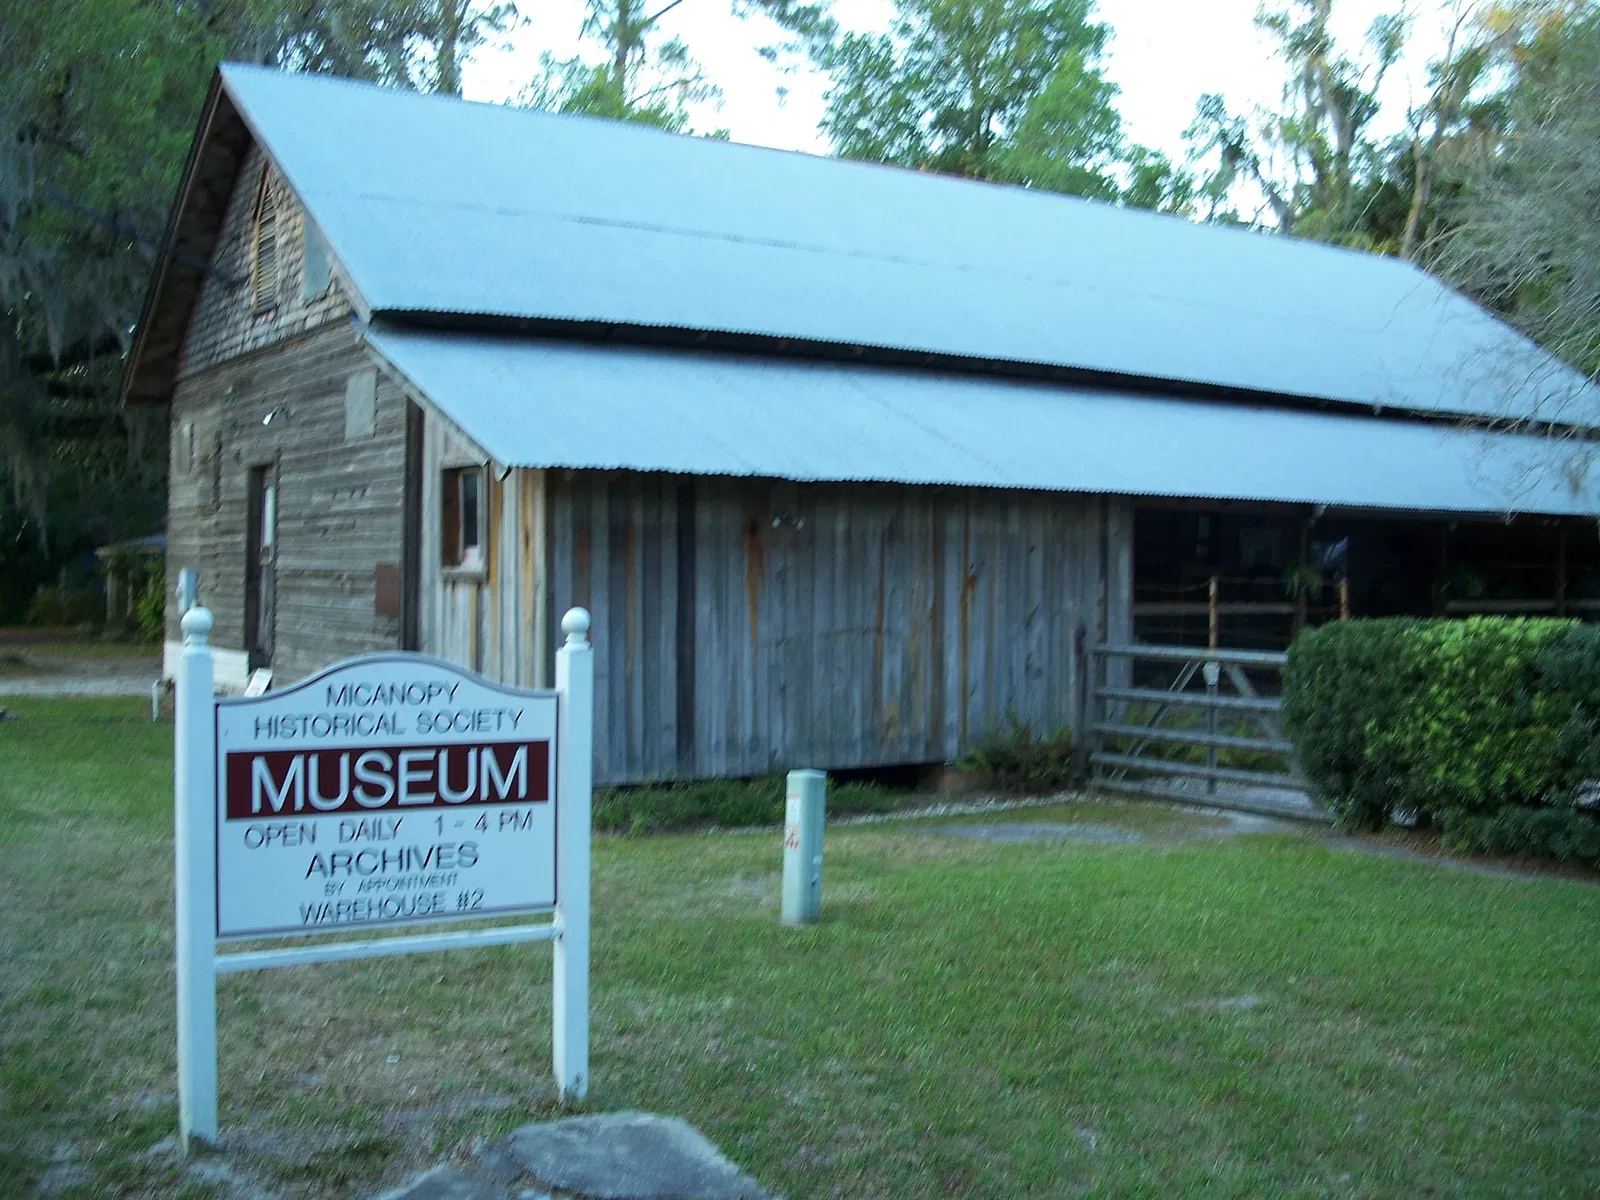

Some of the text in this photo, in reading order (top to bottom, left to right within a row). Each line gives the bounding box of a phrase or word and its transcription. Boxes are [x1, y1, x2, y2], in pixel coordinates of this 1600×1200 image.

[326, 681, 460, 708] MICANOPY
[254, 708, 524, 740] HISTORICAL SOCIETY
[251, 744, 529, 815] MUSEUM
[244, 819, 316, 850] OPEN
[339, 816, 404, 845] DAILY
[433, 814, 444, 837] 1
[474, 811, 489, 834] 4
[499, 808, 532, 834] PM
[304, 840, 479, 879] ARCHIVES
[324, 872, 458, 897] BY APPOINTMENT
[300, 889, 485, 925] WAREHOUSE #2
